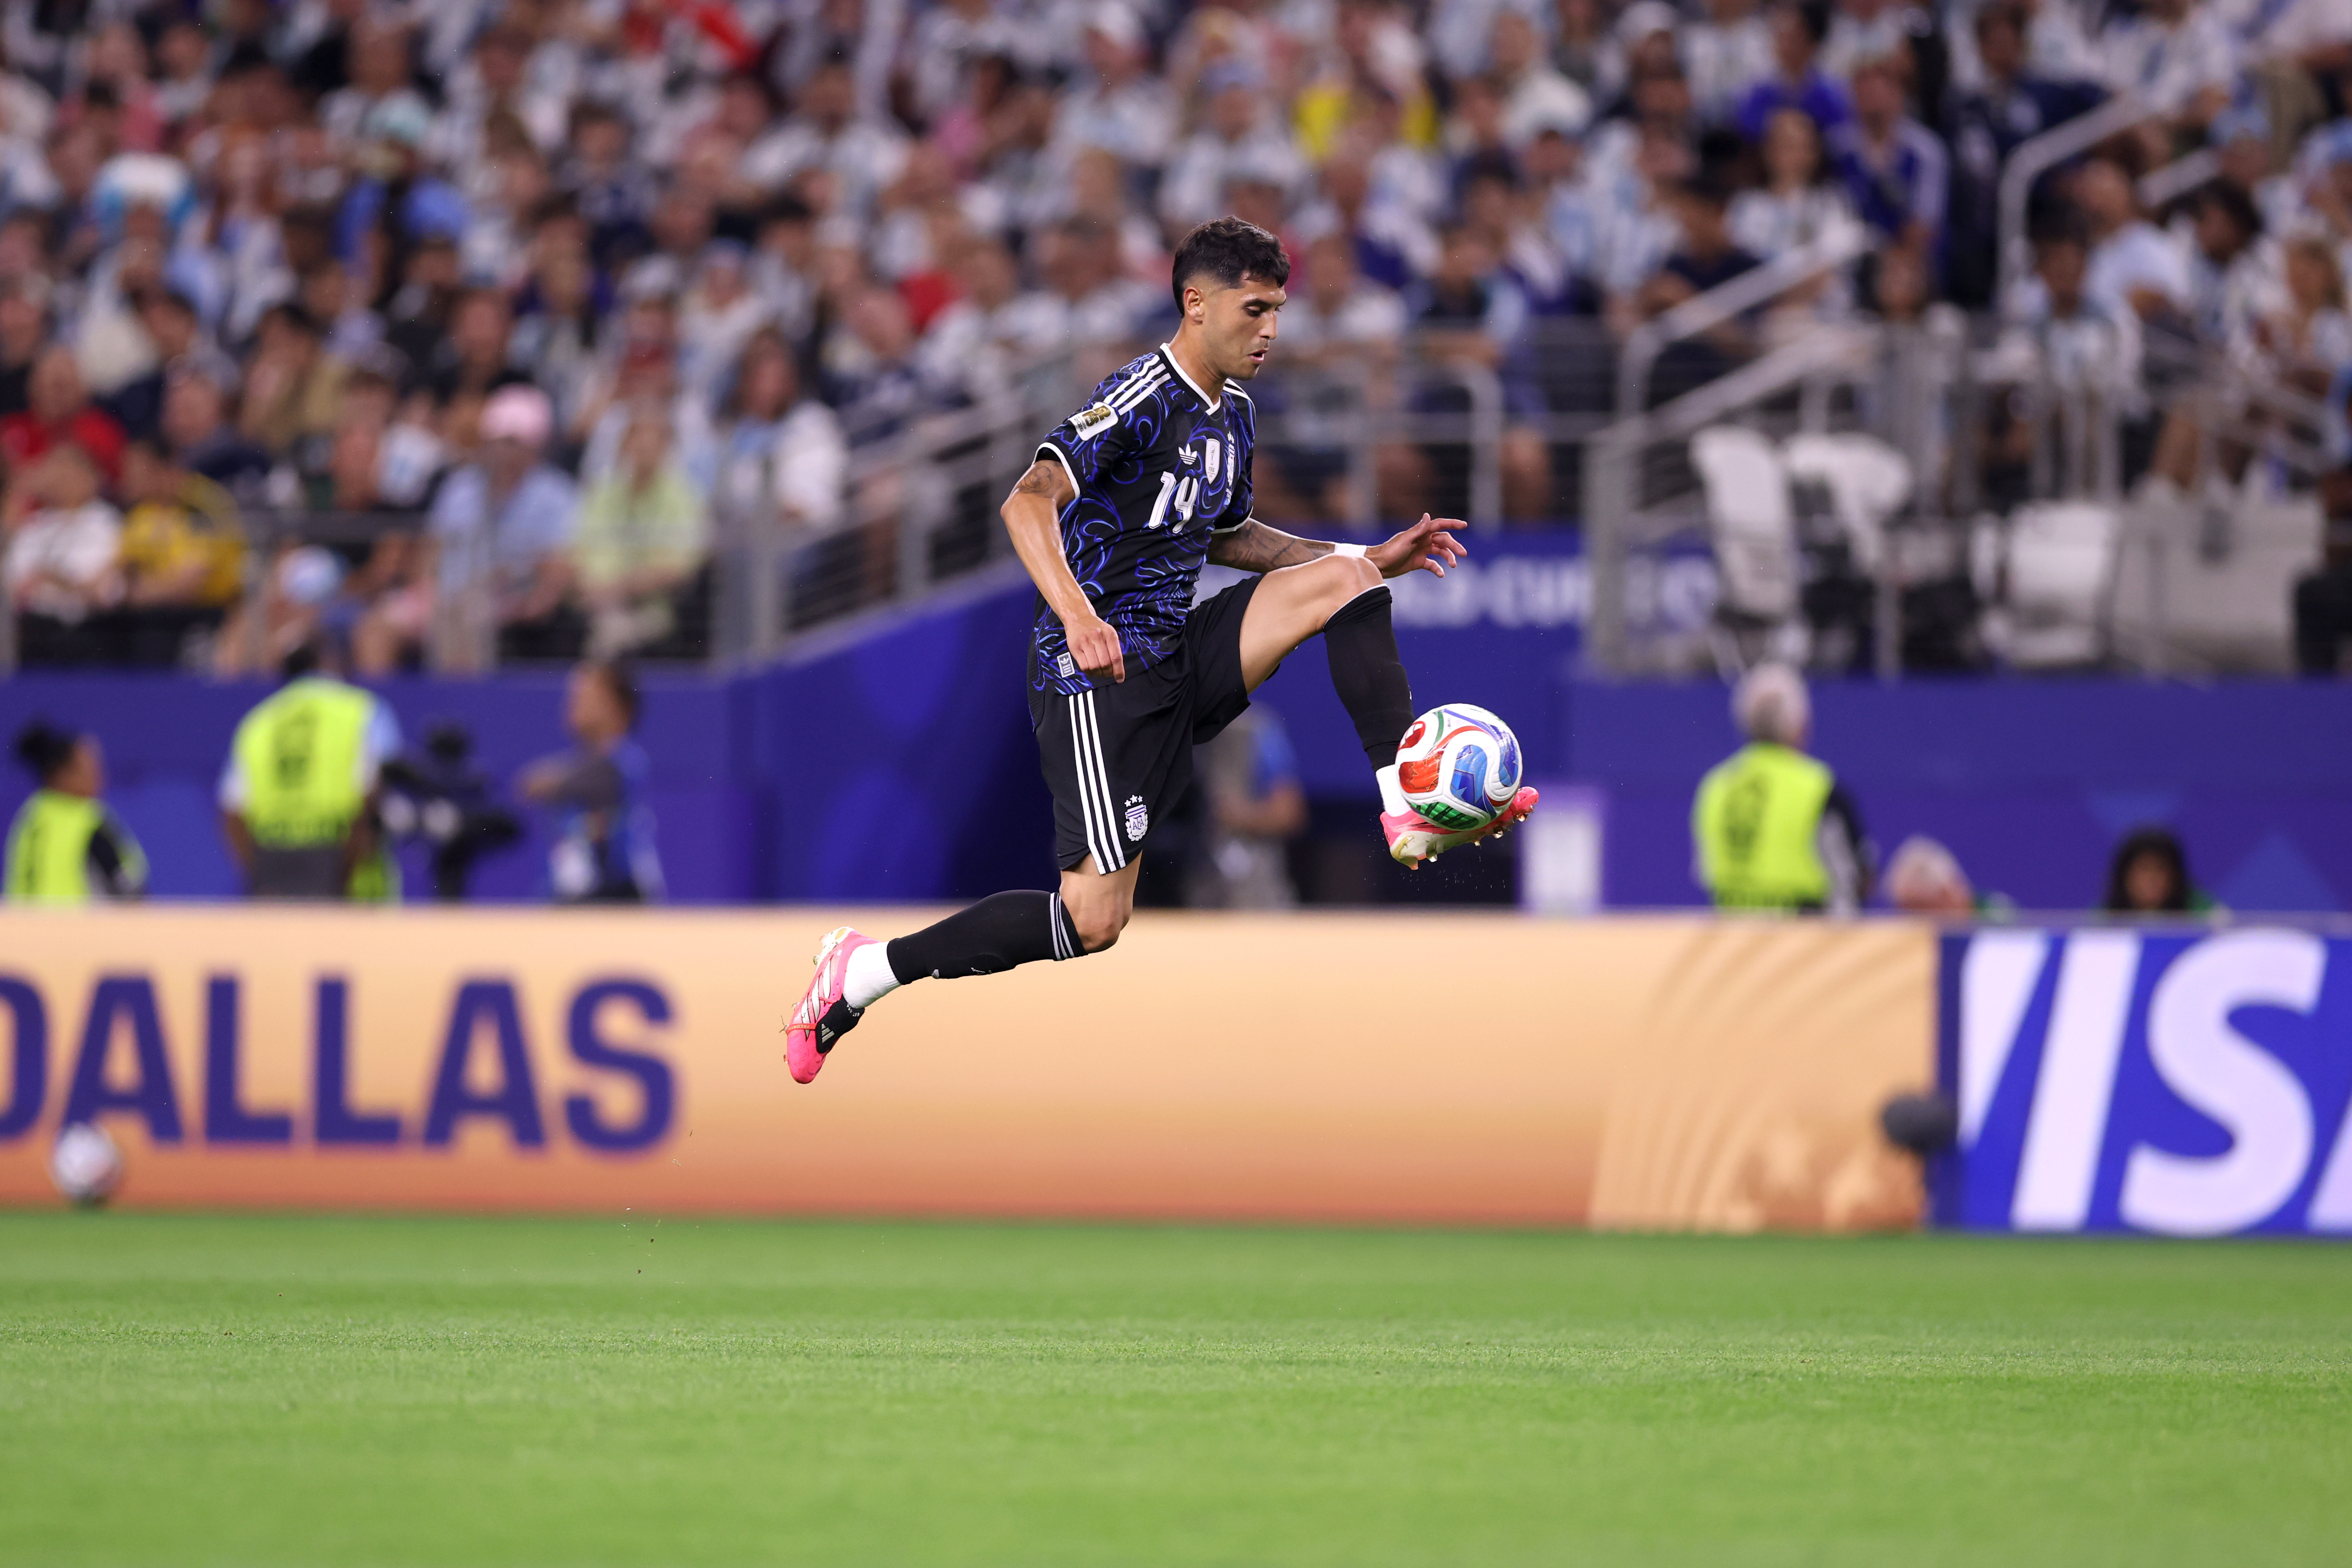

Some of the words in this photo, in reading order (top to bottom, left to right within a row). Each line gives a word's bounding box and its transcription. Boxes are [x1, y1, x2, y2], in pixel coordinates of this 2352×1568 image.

[1074, 418, 1084, 432] 2026
[1148, 471, 1199, 534] 14
[1960, 927, 2352, 1238] IS
